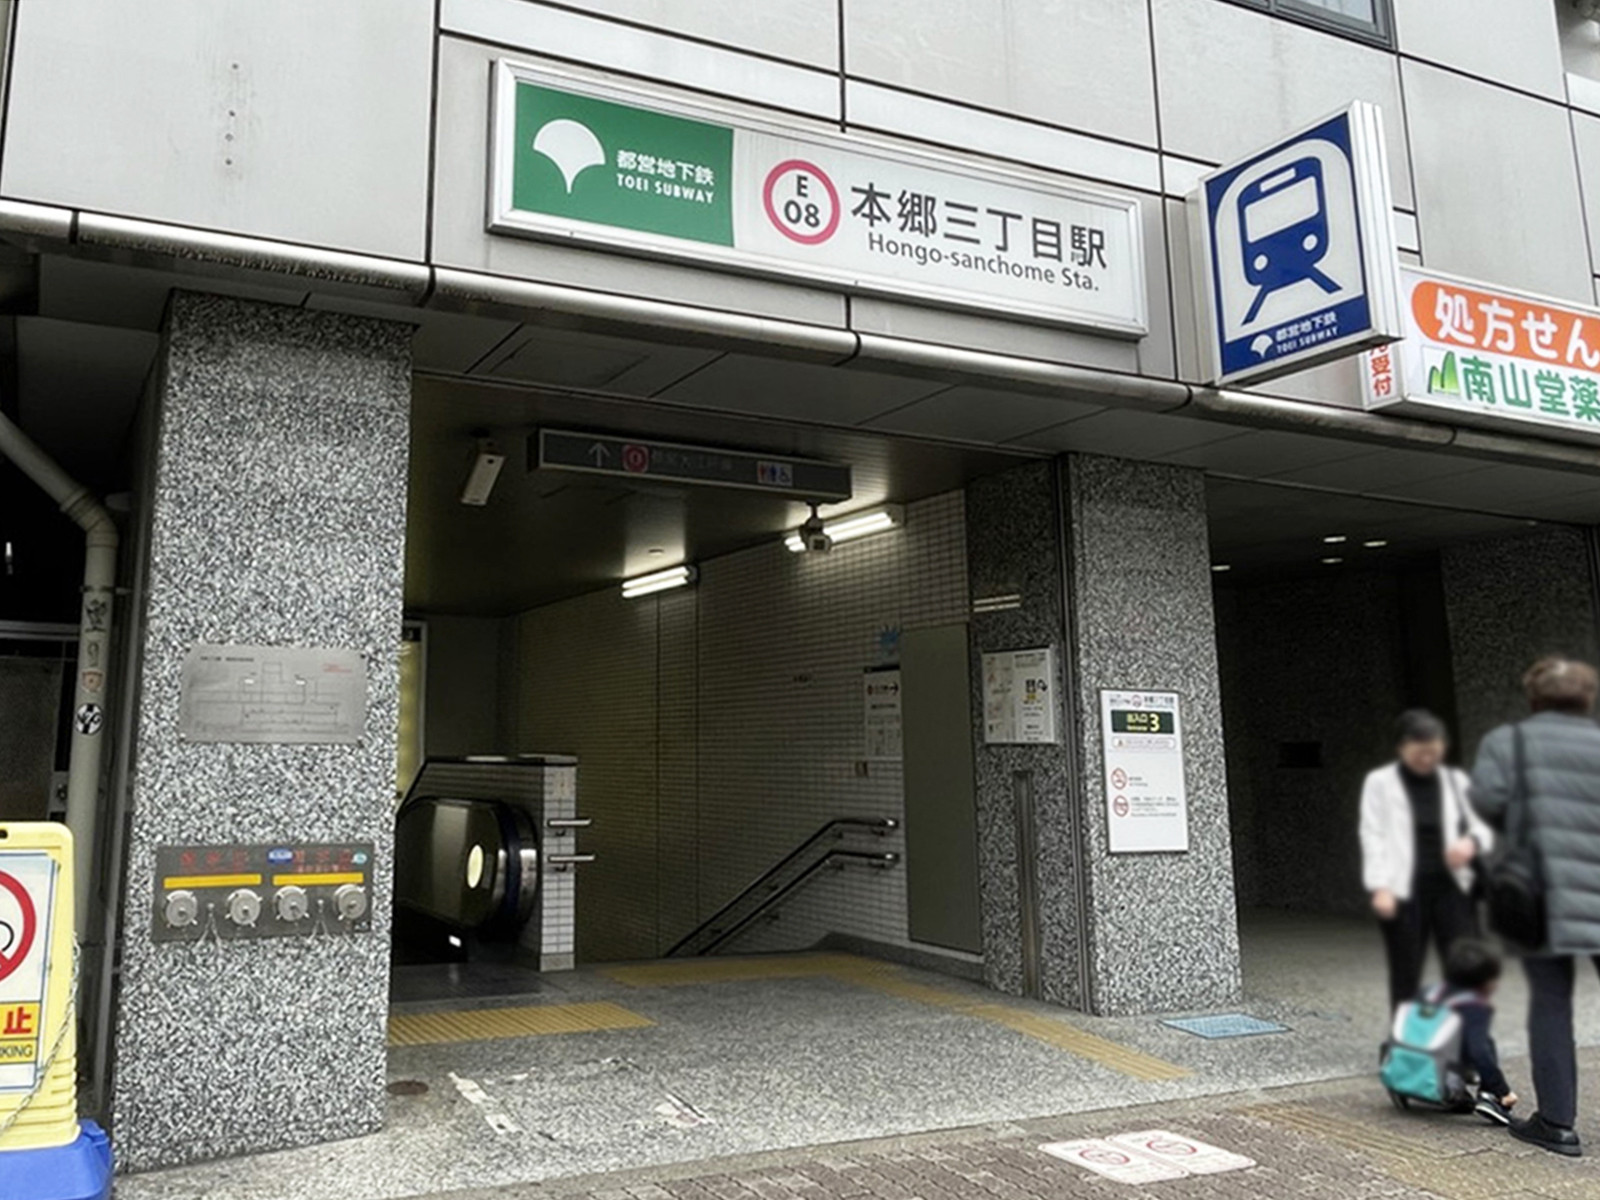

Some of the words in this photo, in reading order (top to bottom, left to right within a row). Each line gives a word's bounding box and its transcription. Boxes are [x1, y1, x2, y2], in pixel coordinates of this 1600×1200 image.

[617, 149, 714, 187] 都営地下鉄
[616, 173, 648, 192] TOEI
[654, 180, 714, 204] SUBWAY
[796, 174, 808, 198] E
[784, 200, 820, 228] 08
[851, 182, 1107, 269] 本郷三丁目駅
[868, 232, 1056, 284] Hongo-sanchome
[1061, 267, 1099, 292] Sta.
[1435, 287, 1600, 368] 処方せん
[1460, 354, 1600, 422] 南山堂薬
[1149, 713, 1160, 732] 3
[3, 1006, 32, 1034] 止
